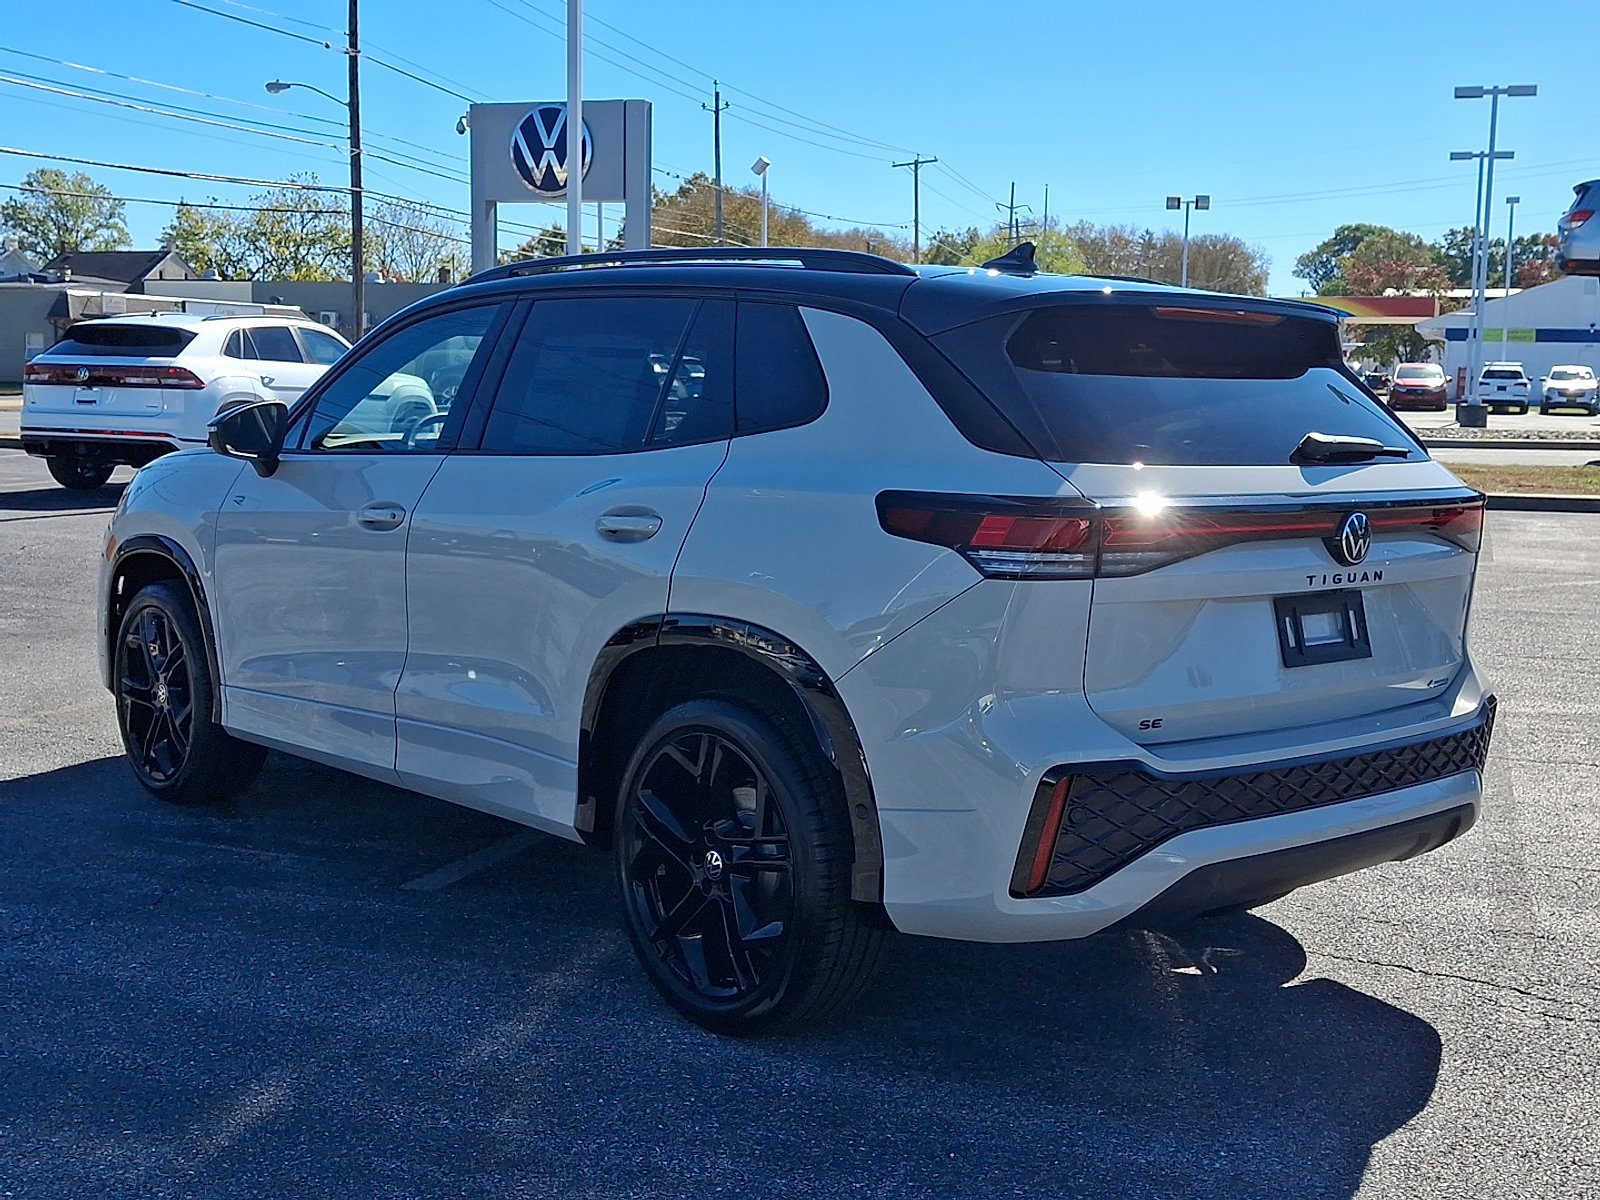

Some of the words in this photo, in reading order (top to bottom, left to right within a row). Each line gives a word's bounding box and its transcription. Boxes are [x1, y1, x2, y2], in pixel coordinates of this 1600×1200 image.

[1342, 512, 1370, 563] VW
[1306, 570, 1383, 586] TIGUAN
[1139, 718, 1163, 730] SE
